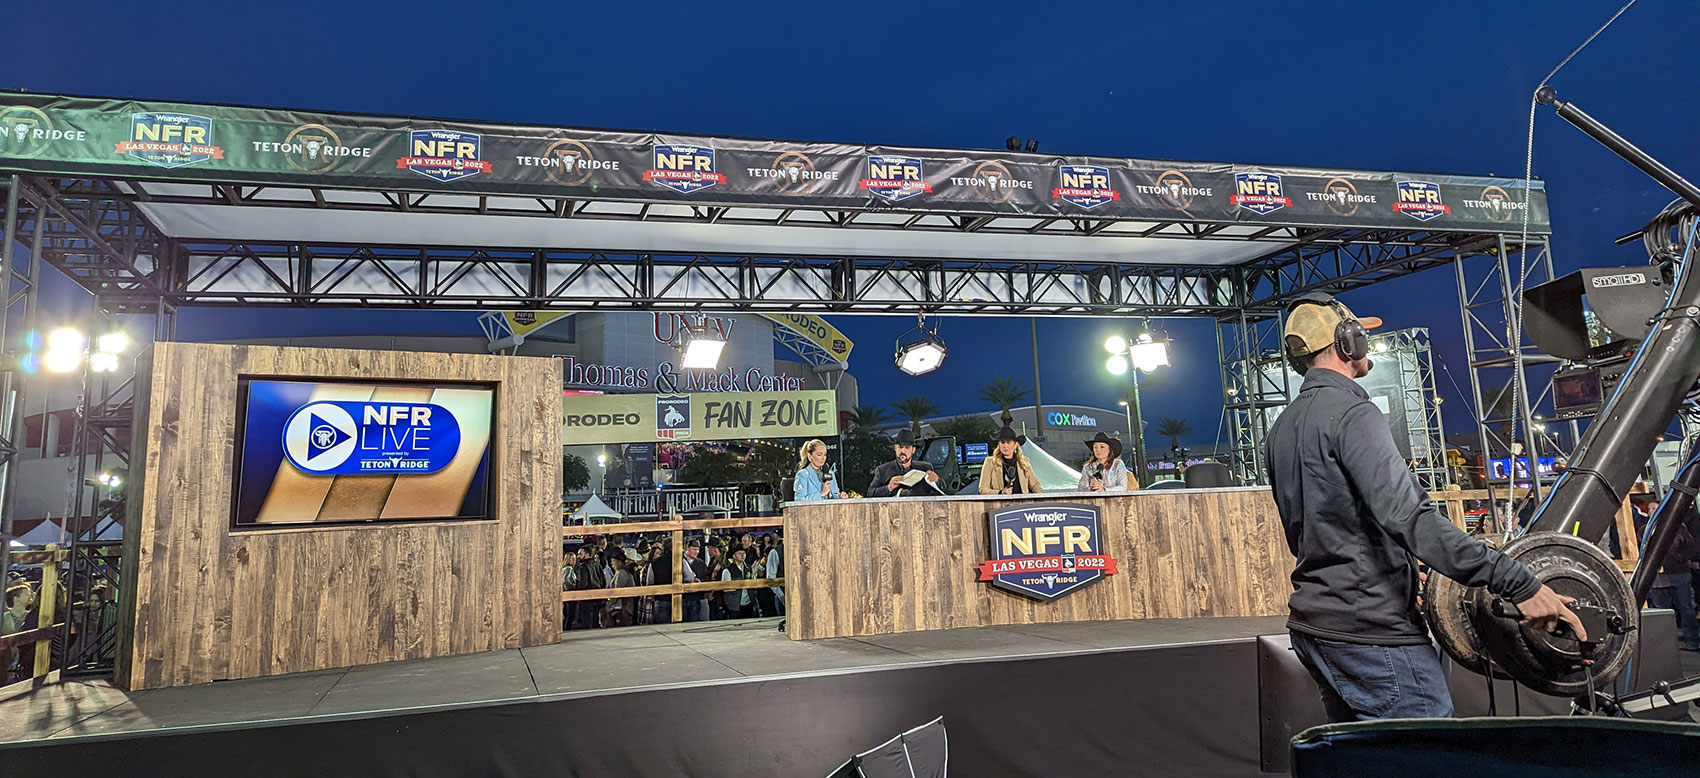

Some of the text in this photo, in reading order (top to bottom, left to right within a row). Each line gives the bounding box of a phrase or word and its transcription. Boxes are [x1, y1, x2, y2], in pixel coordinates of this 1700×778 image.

[155, 115, 190, 125] Wrangler
[33, 129, 87, 141] RIDGE
[135, 123, 208, 144] NFR
[430, 131, 461, 142] Wrangler
[125, 142, 215, 154] LAS VEGAS 2022
[253, 141, 370, 158] TETON RIDGE
[414, 140, 476, 159] NFR
[671, 146, 698, 156] Wrangler
[516, 155, 620, 171] TETON RIDGE
[657, 153, 712, 171] NFR
[882, 156, 906, 166] Wrangler
[747, 168, 838, 180] TETON RIDGE
[870, 163, 919, 180] NFR
[1071, 167, 1094, 176] Wrangler
[950, 177, 1033, 190] TETON RIDGE
[1063, 173, 1108, 189] NFR
[1136, 185, 1212, 197] TETON RIDGE
[1239, 181, 1280, 196] NFR
[1306, 192, 1377, 204] TETON RIDGE
[1400, 189, 1440, 203] NFR
[1463, 200, 1491, 209] TETON
[786, 314, 827, 339] ODEO
[654, 361, 682, 395] &
[684, 369, 740, 391] Mack
[745, 367, 806, 391] Center
[363, 405, 432, 427] NFR
[563, 413, 641, 427] RODEO
[704, 399, 829, 429] FAN ZONE
[1048, 411, 1071, 426] COX
[361, 427, 431, 451] LIVE
[361, 461, 429, 469] TETON RIDGE
[666, 490, 740, 512] MERCHANDISE
[1024, 512, 1067, 526] Wrangler
[1001, 525, 1093, 556] NFR
[992, 558, 1105, 572] LAS VEGAS 2022
